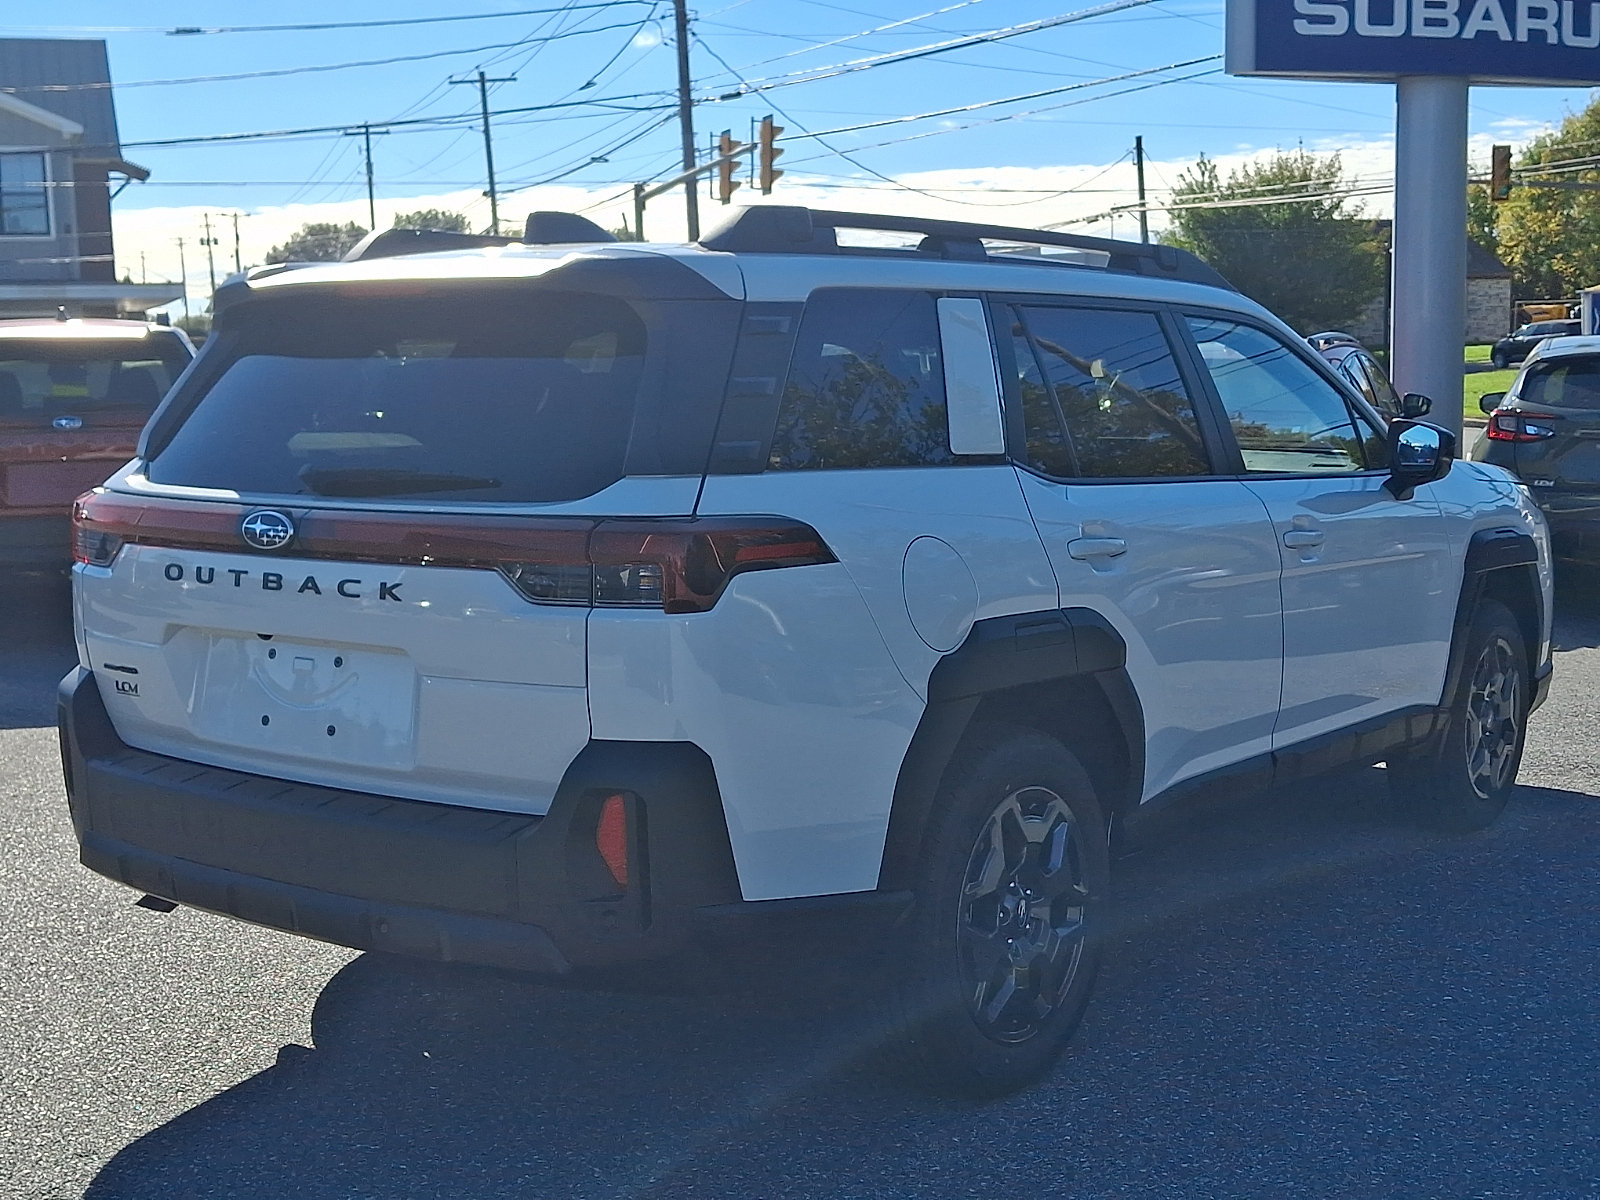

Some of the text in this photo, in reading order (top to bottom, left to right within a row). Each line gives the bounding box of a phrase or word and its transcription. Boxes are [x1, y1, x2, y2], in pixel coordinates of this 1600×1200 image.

[1293, 0, 1600, 48] SUBARU
[164, 562, 404, 602] OUTBACK
[115, 680, 138, 694] LCM
